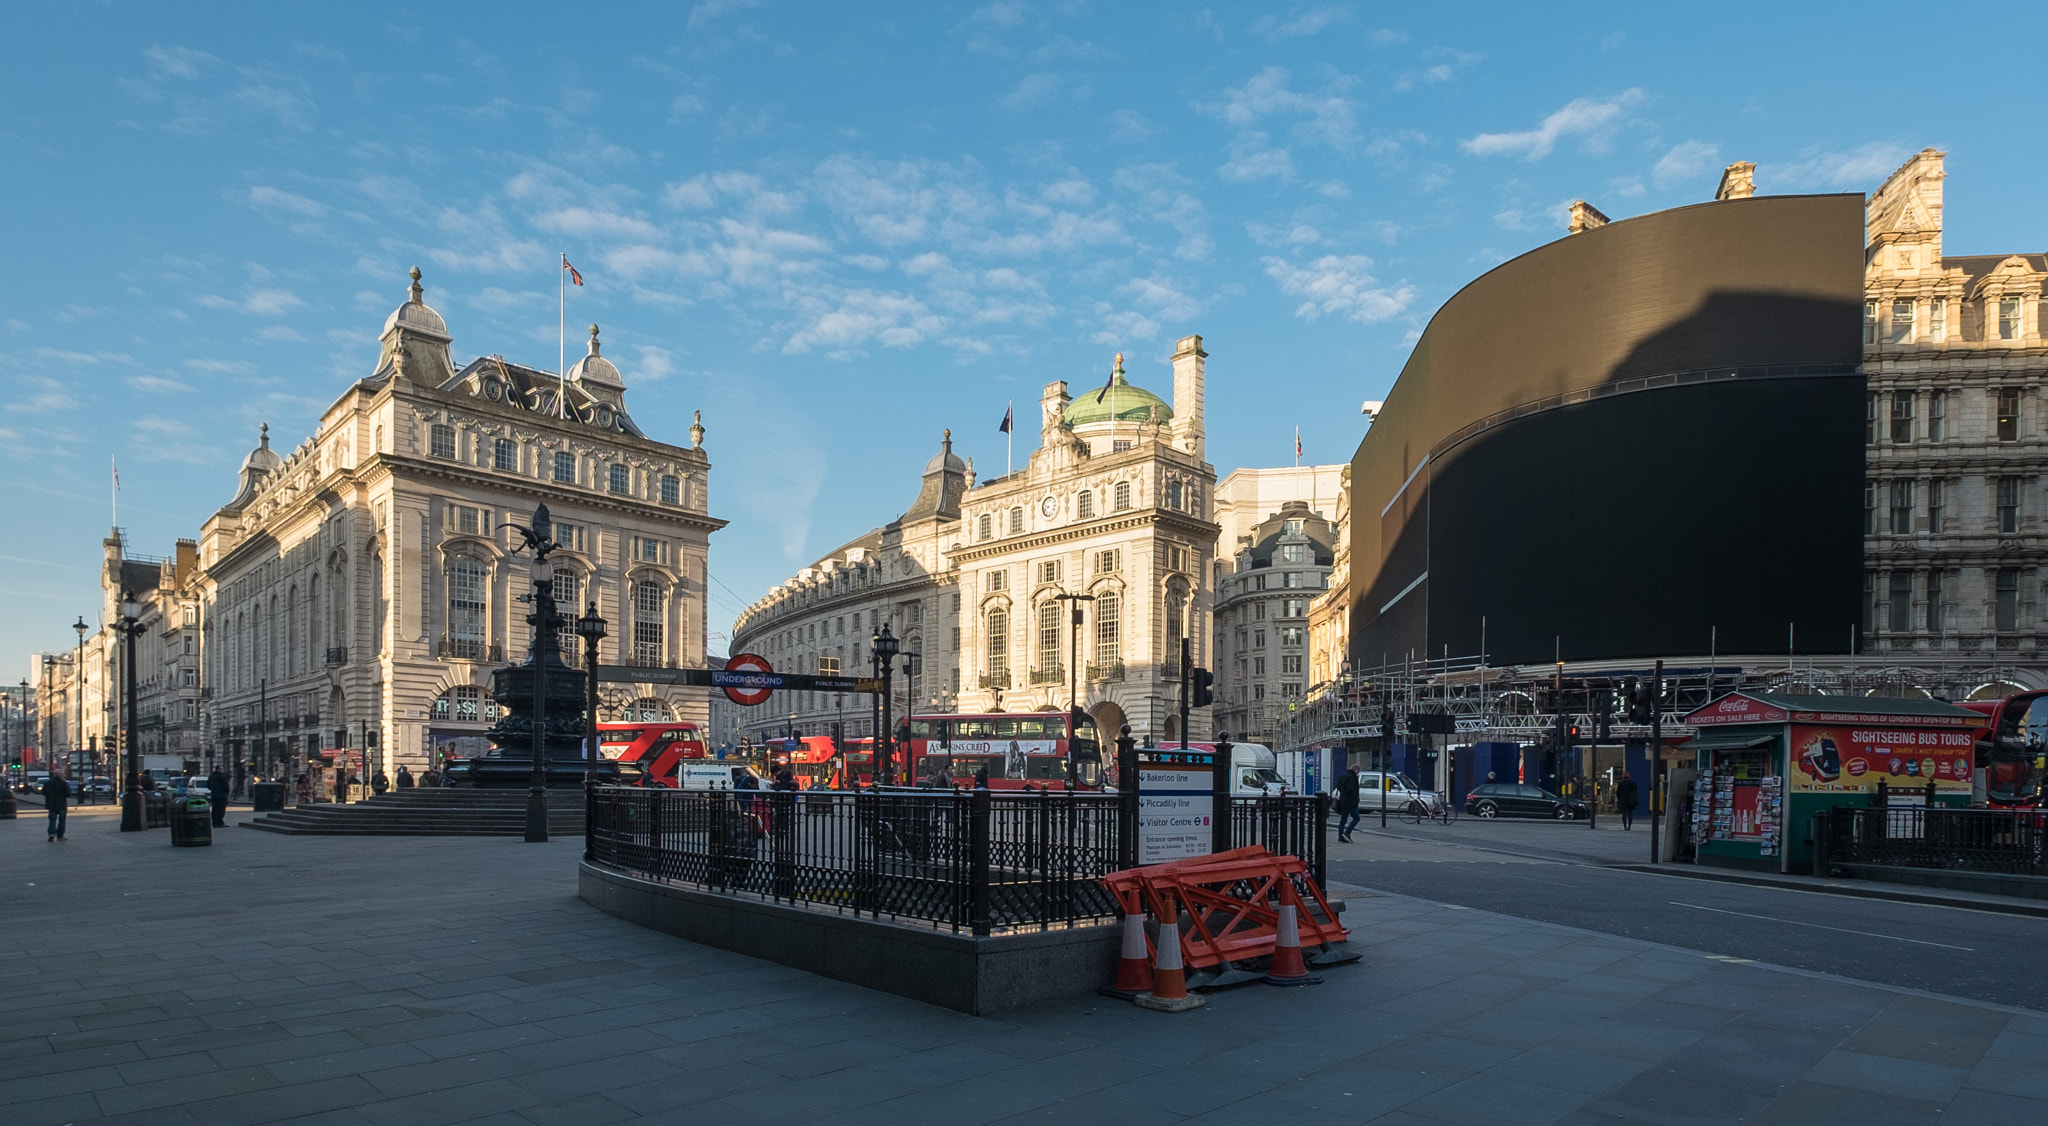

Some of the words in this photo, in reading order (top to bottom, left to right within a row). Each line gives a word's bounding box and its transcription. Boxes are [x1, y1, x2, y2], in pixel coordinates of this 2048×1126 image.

[714, 674, 783, 686] UNDERGROUND
[1820, 714, 1858, 722] SIGHTSEEING
[1852, 730, 1916, 744] SIGHTSEEING
[1918, 733, 1938, 745] BUS
[1940, 734, 1971, 746] TOURS
[966, 742, 991, 753] CREED
[1146, 773, 1174, 782] Bakerloo
[1176, 774, 1188, 782] line
[1146, 799, 1176, 809] Piccadilly
[1146, 818, 1168, 827] Visitor
[1170, 818, 1192, 826] Centre
